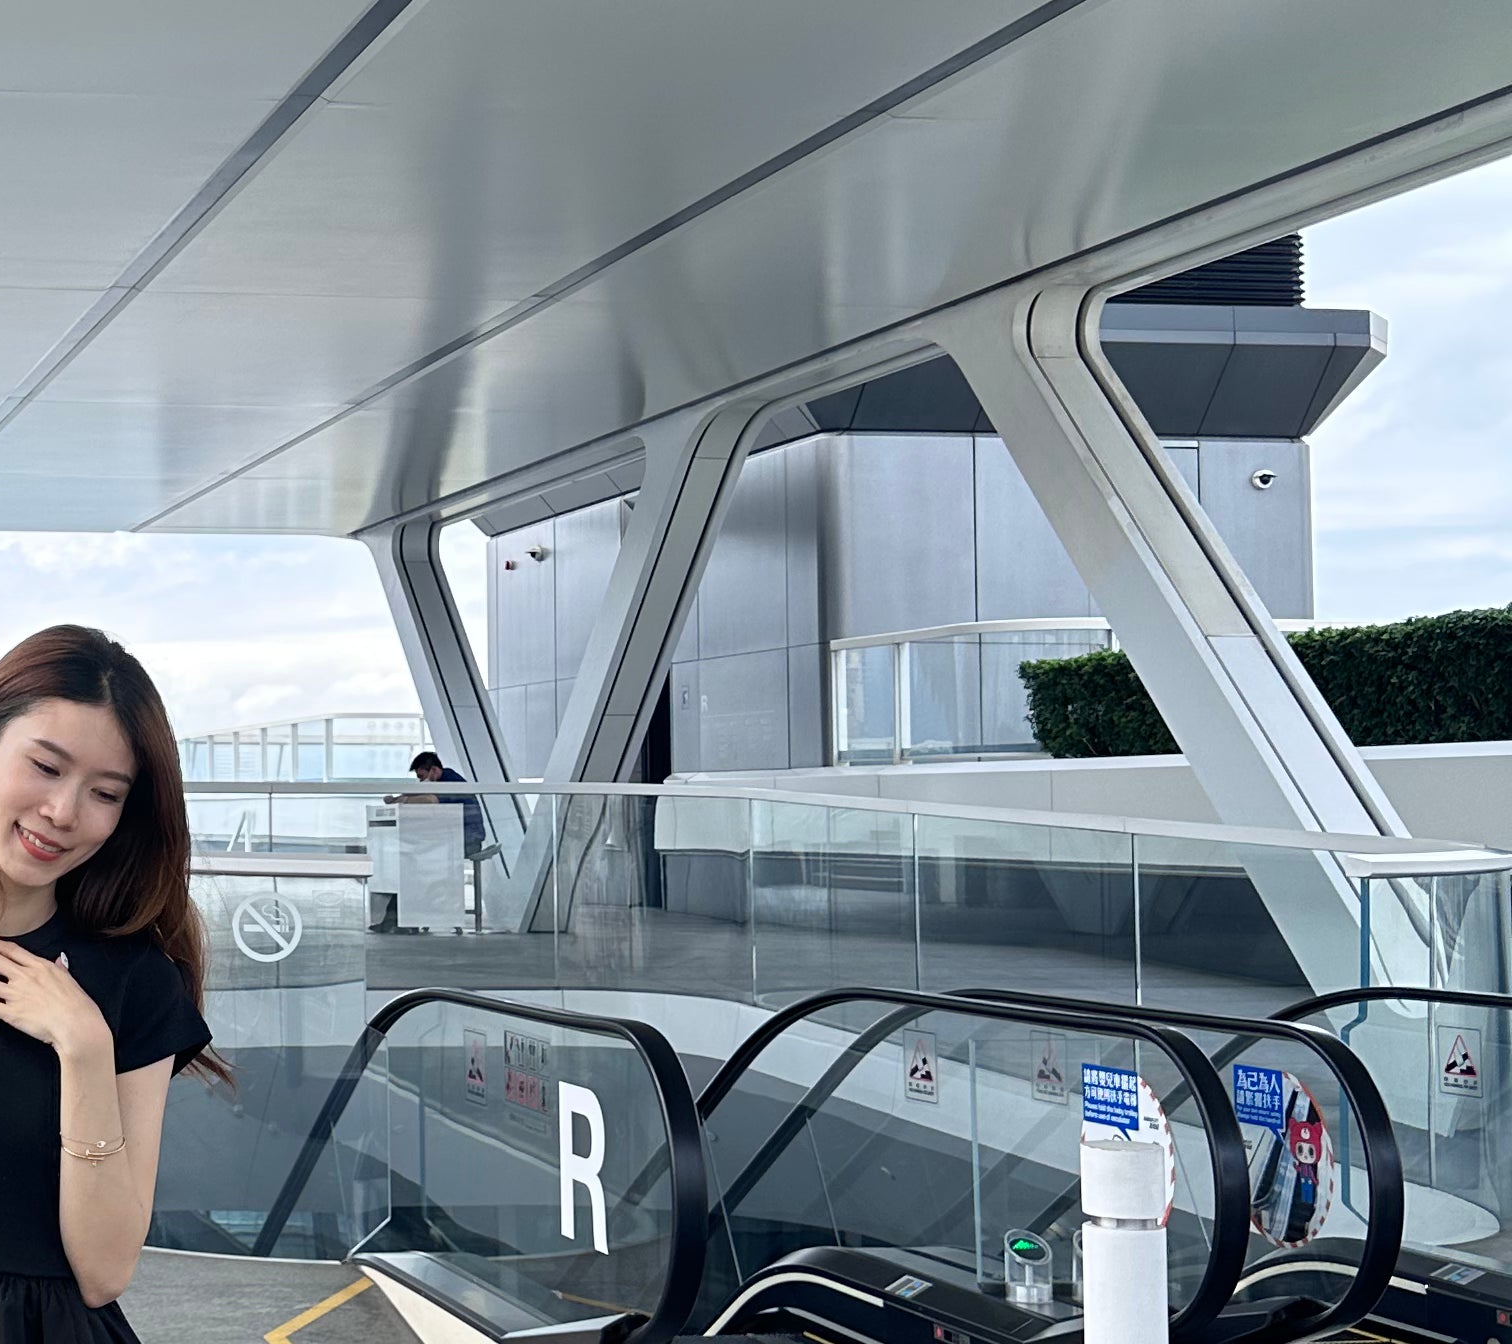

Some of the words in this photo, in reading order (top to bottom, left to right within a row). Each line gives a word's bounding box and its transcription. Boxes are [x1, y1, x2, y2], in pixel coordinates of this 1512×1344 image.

[1237, 1069, 1280, 1094] 為己為人
[559, 1080, 609, 1256] R
